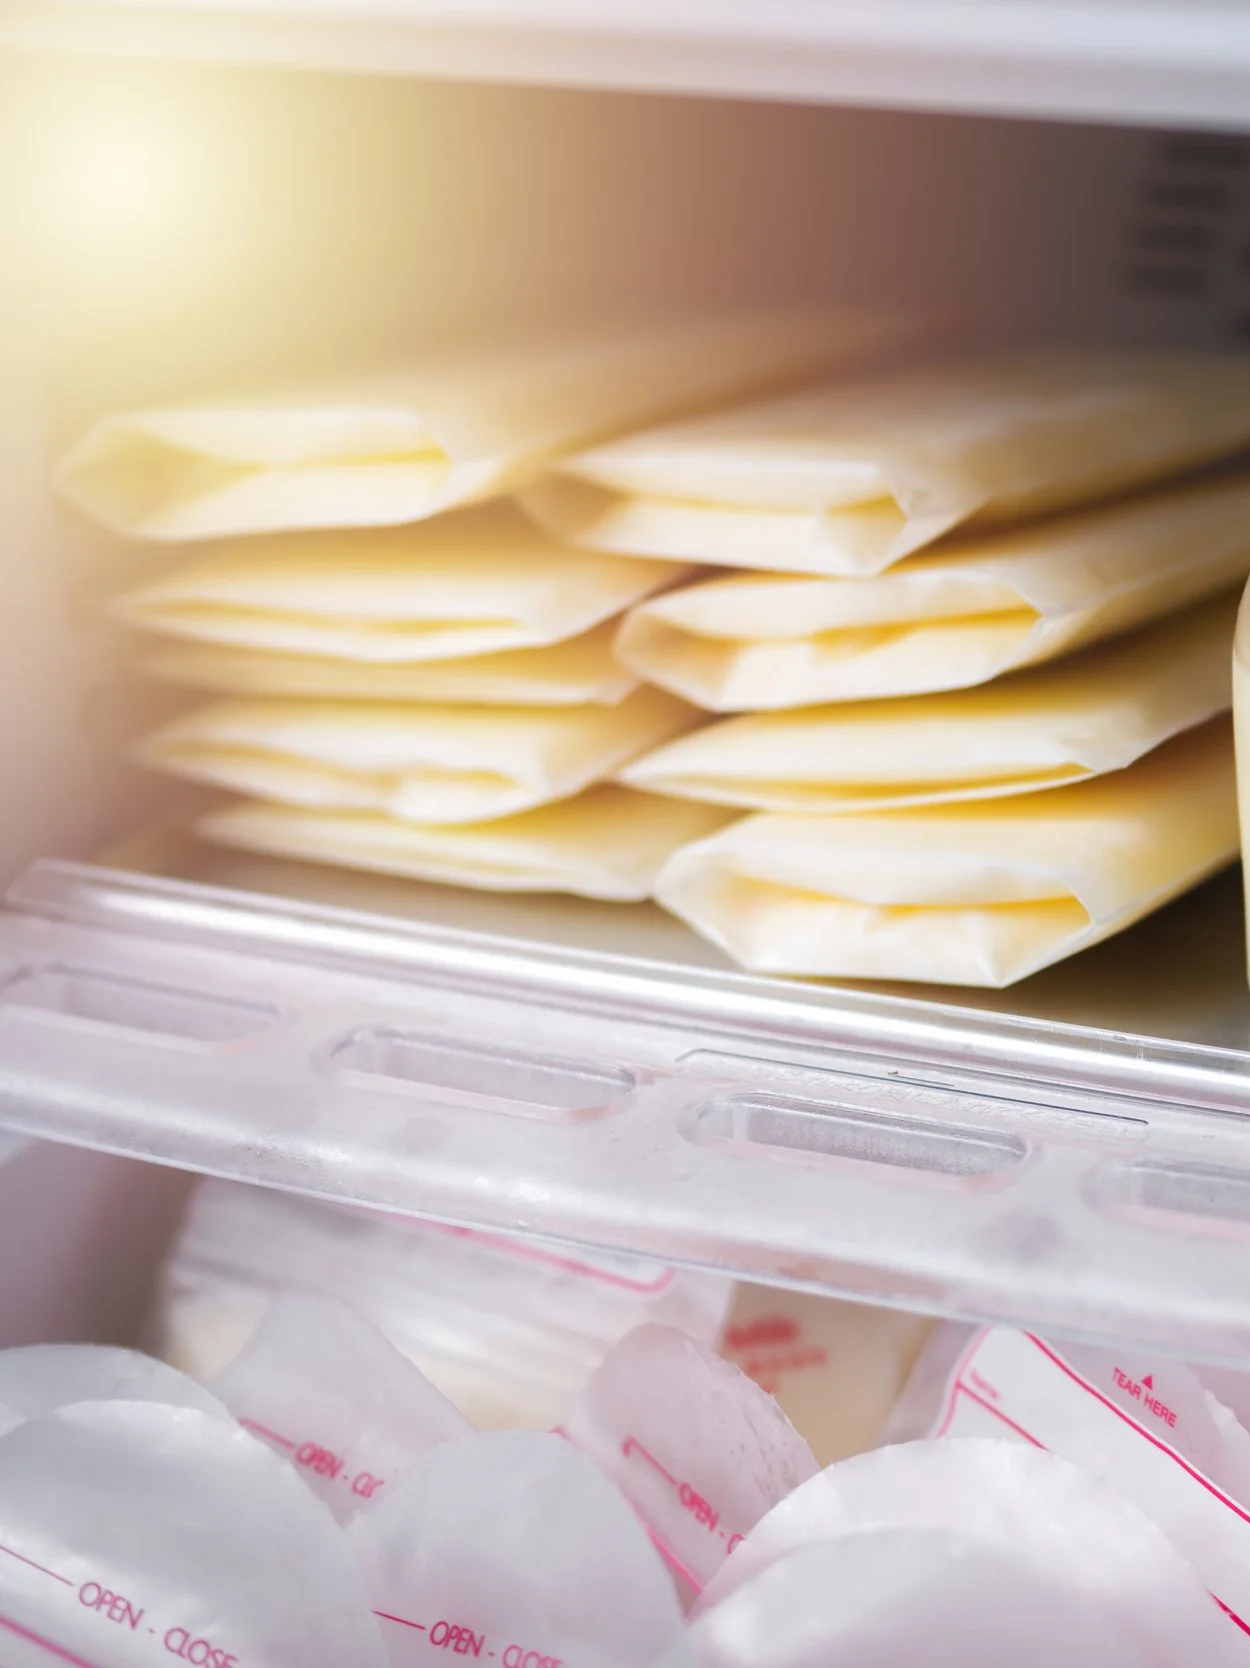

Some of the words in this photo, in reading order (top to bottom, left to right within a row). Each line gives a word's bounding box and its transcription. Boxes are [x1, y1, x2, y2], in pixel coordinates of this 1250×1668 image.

[1112, 1366, 1142, 1401] TEAR
[1143, 1392, 1178, 1429] HERE
[79, 1581, 145, 1631] OPEN
[429, 1620, 486, 1658] OPEN
